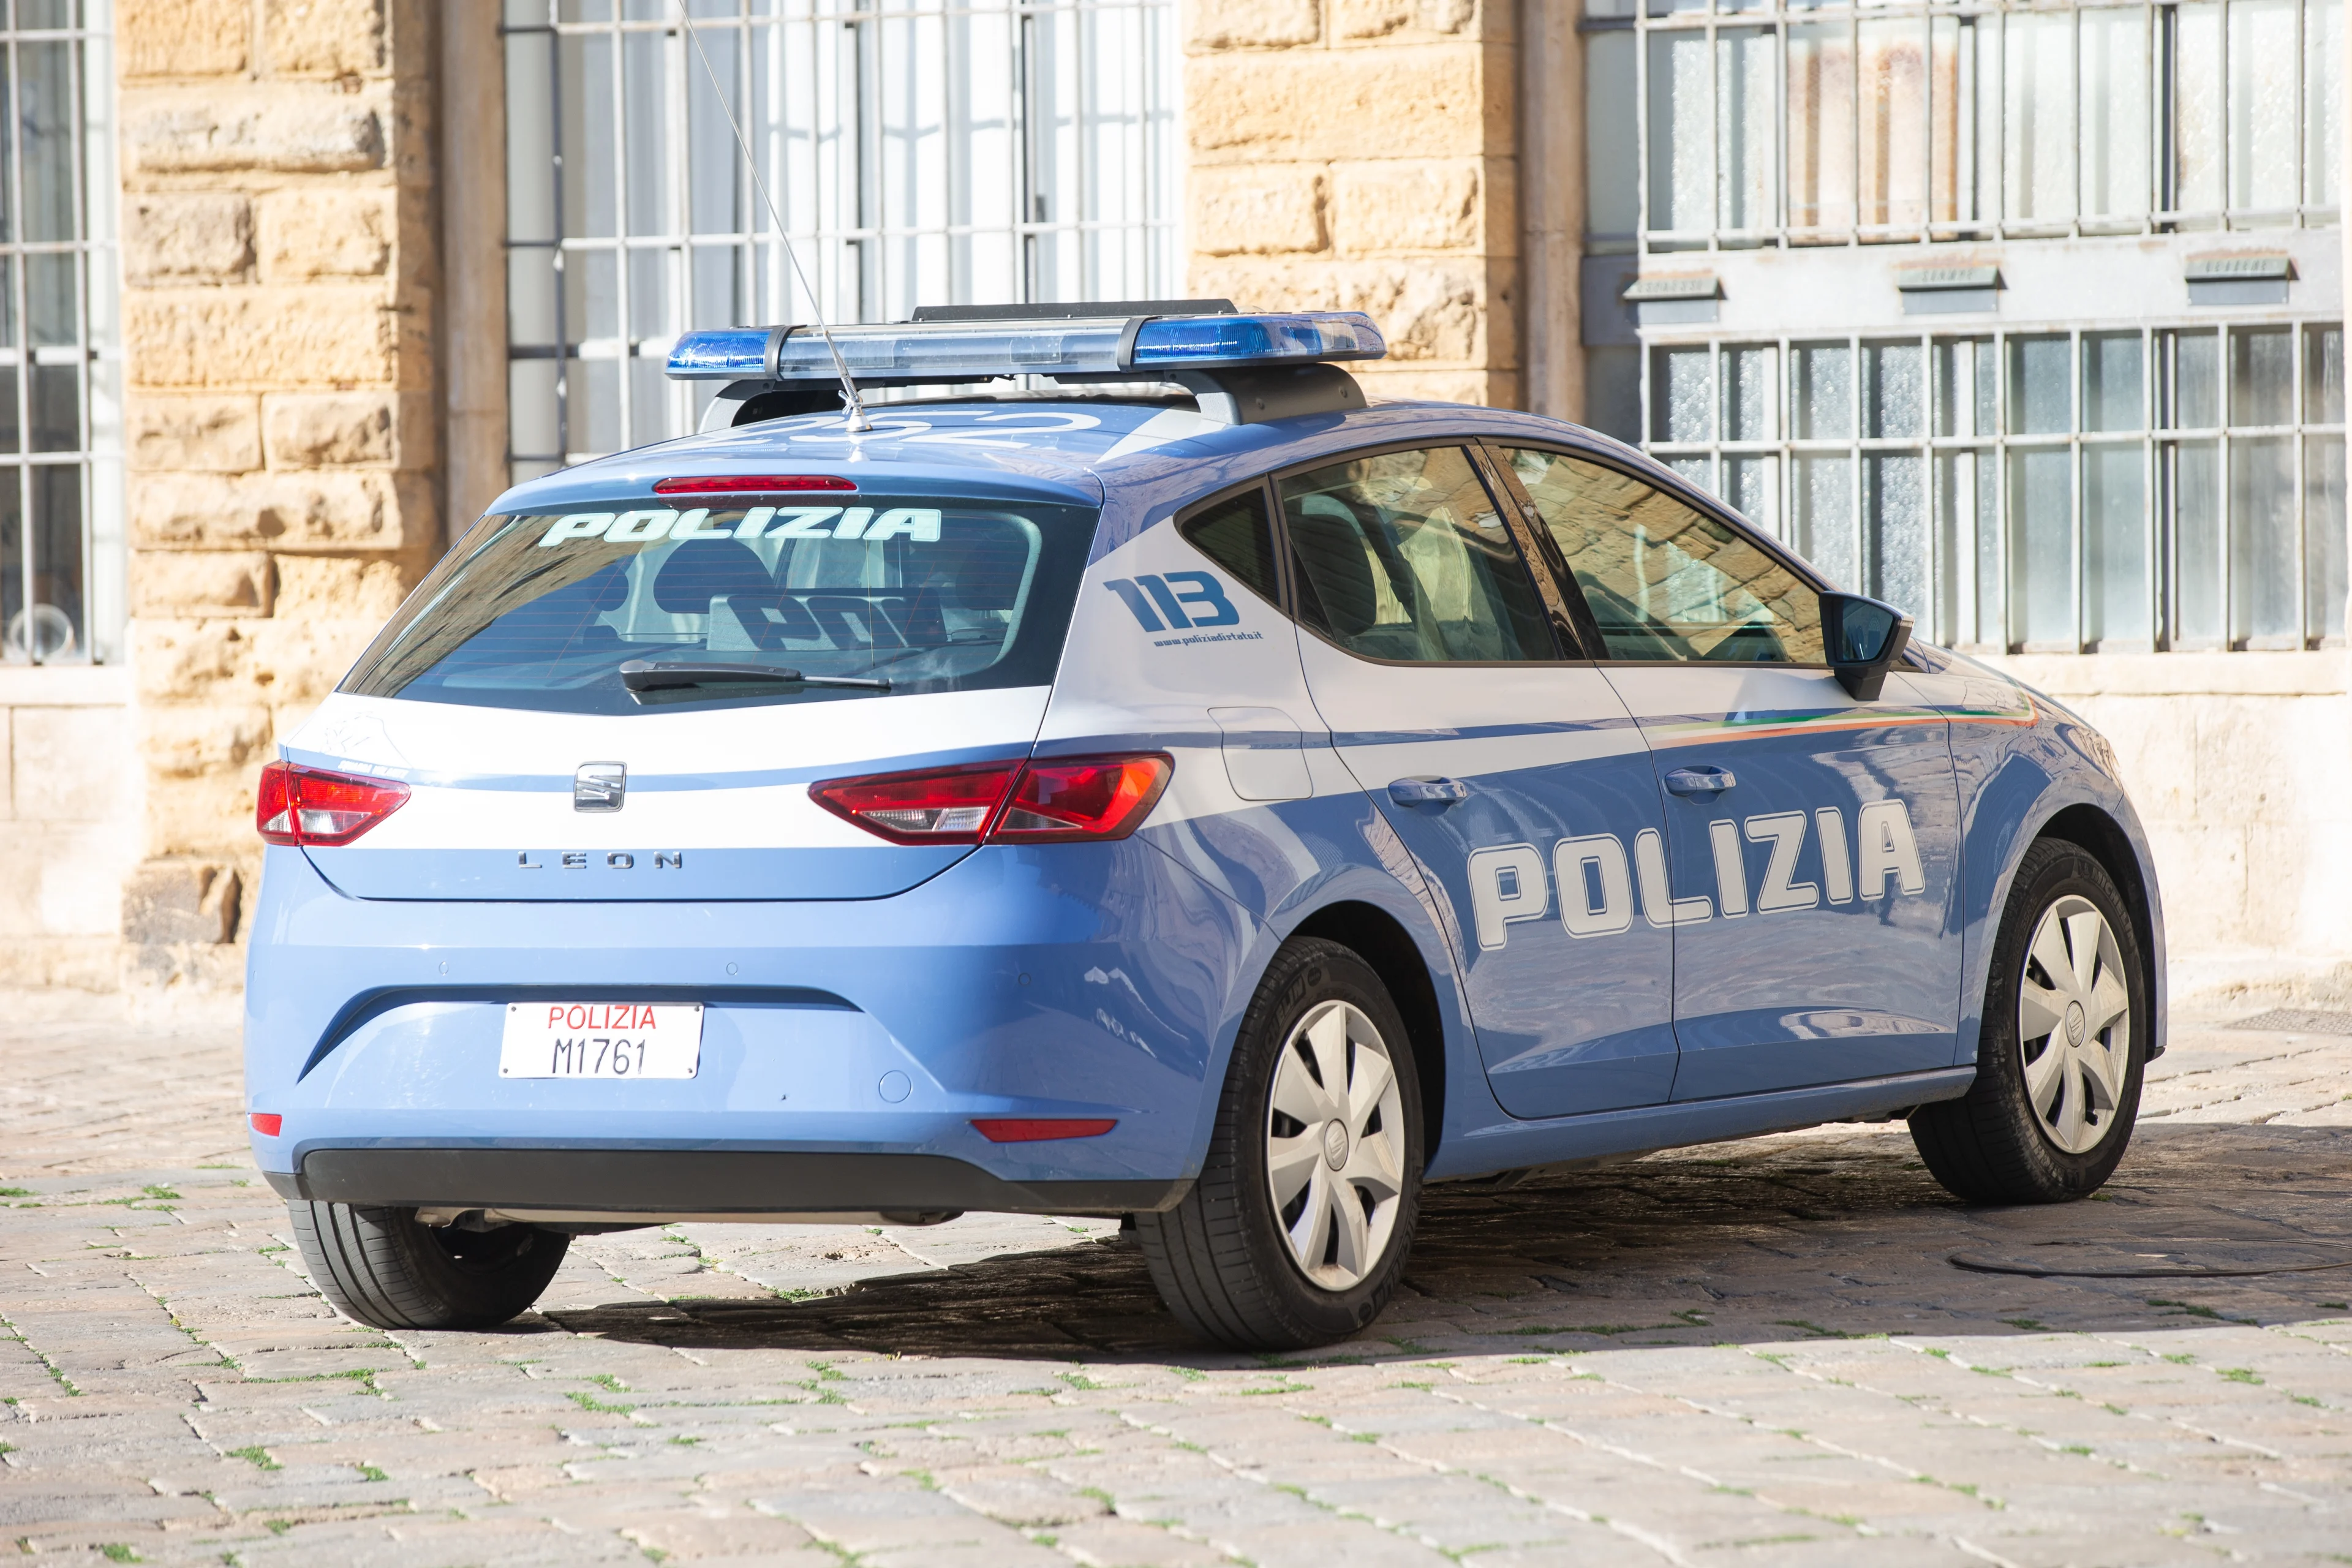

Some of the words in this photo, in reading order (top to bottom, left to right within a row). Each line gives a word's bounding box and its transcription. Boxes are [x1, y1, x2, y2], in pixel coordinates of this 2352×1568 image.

[642, 410, 1101, 454] 252
[538, 507, 942, 546] POLIZIA
[1102, 570, 1240, 632] 113
[1153, 631, 1264, 647] www.poliziadistato.it
[518, 851, 682, 869] LEON
[1468, 799, 1926, 951] POLIZIA
[2091, 862, 2136, 949] MICHELIN
[548, 1005, 656, 1030] POLIZIA
[552, 1039, 646, 1074] M1761
